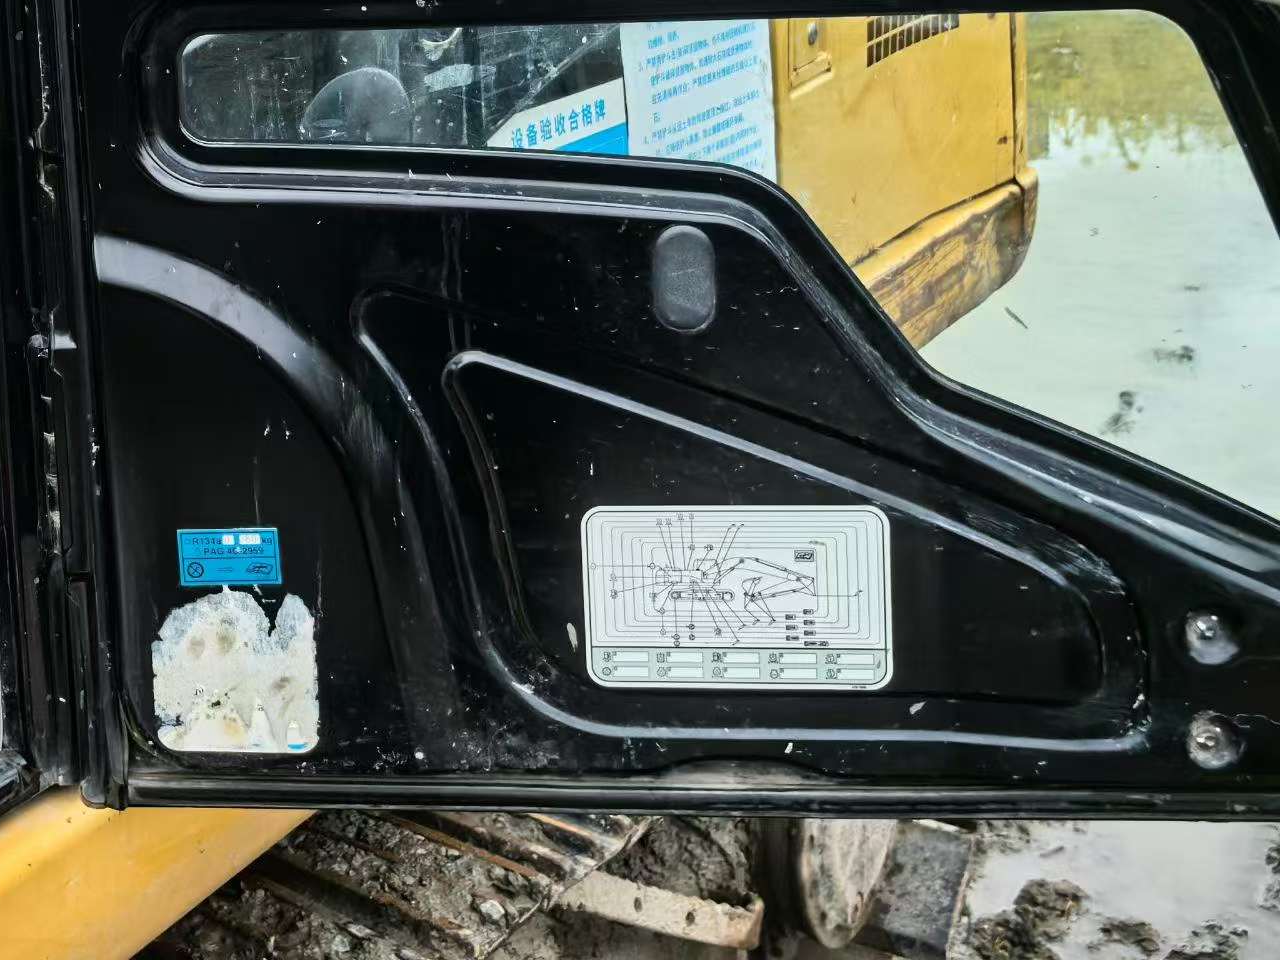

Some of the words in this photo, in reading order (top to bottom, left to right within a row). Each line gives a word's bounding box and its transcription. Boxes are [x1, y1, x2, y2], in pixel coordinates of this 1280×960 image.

[511, 97, 606, 148] 设备验收合格牌
